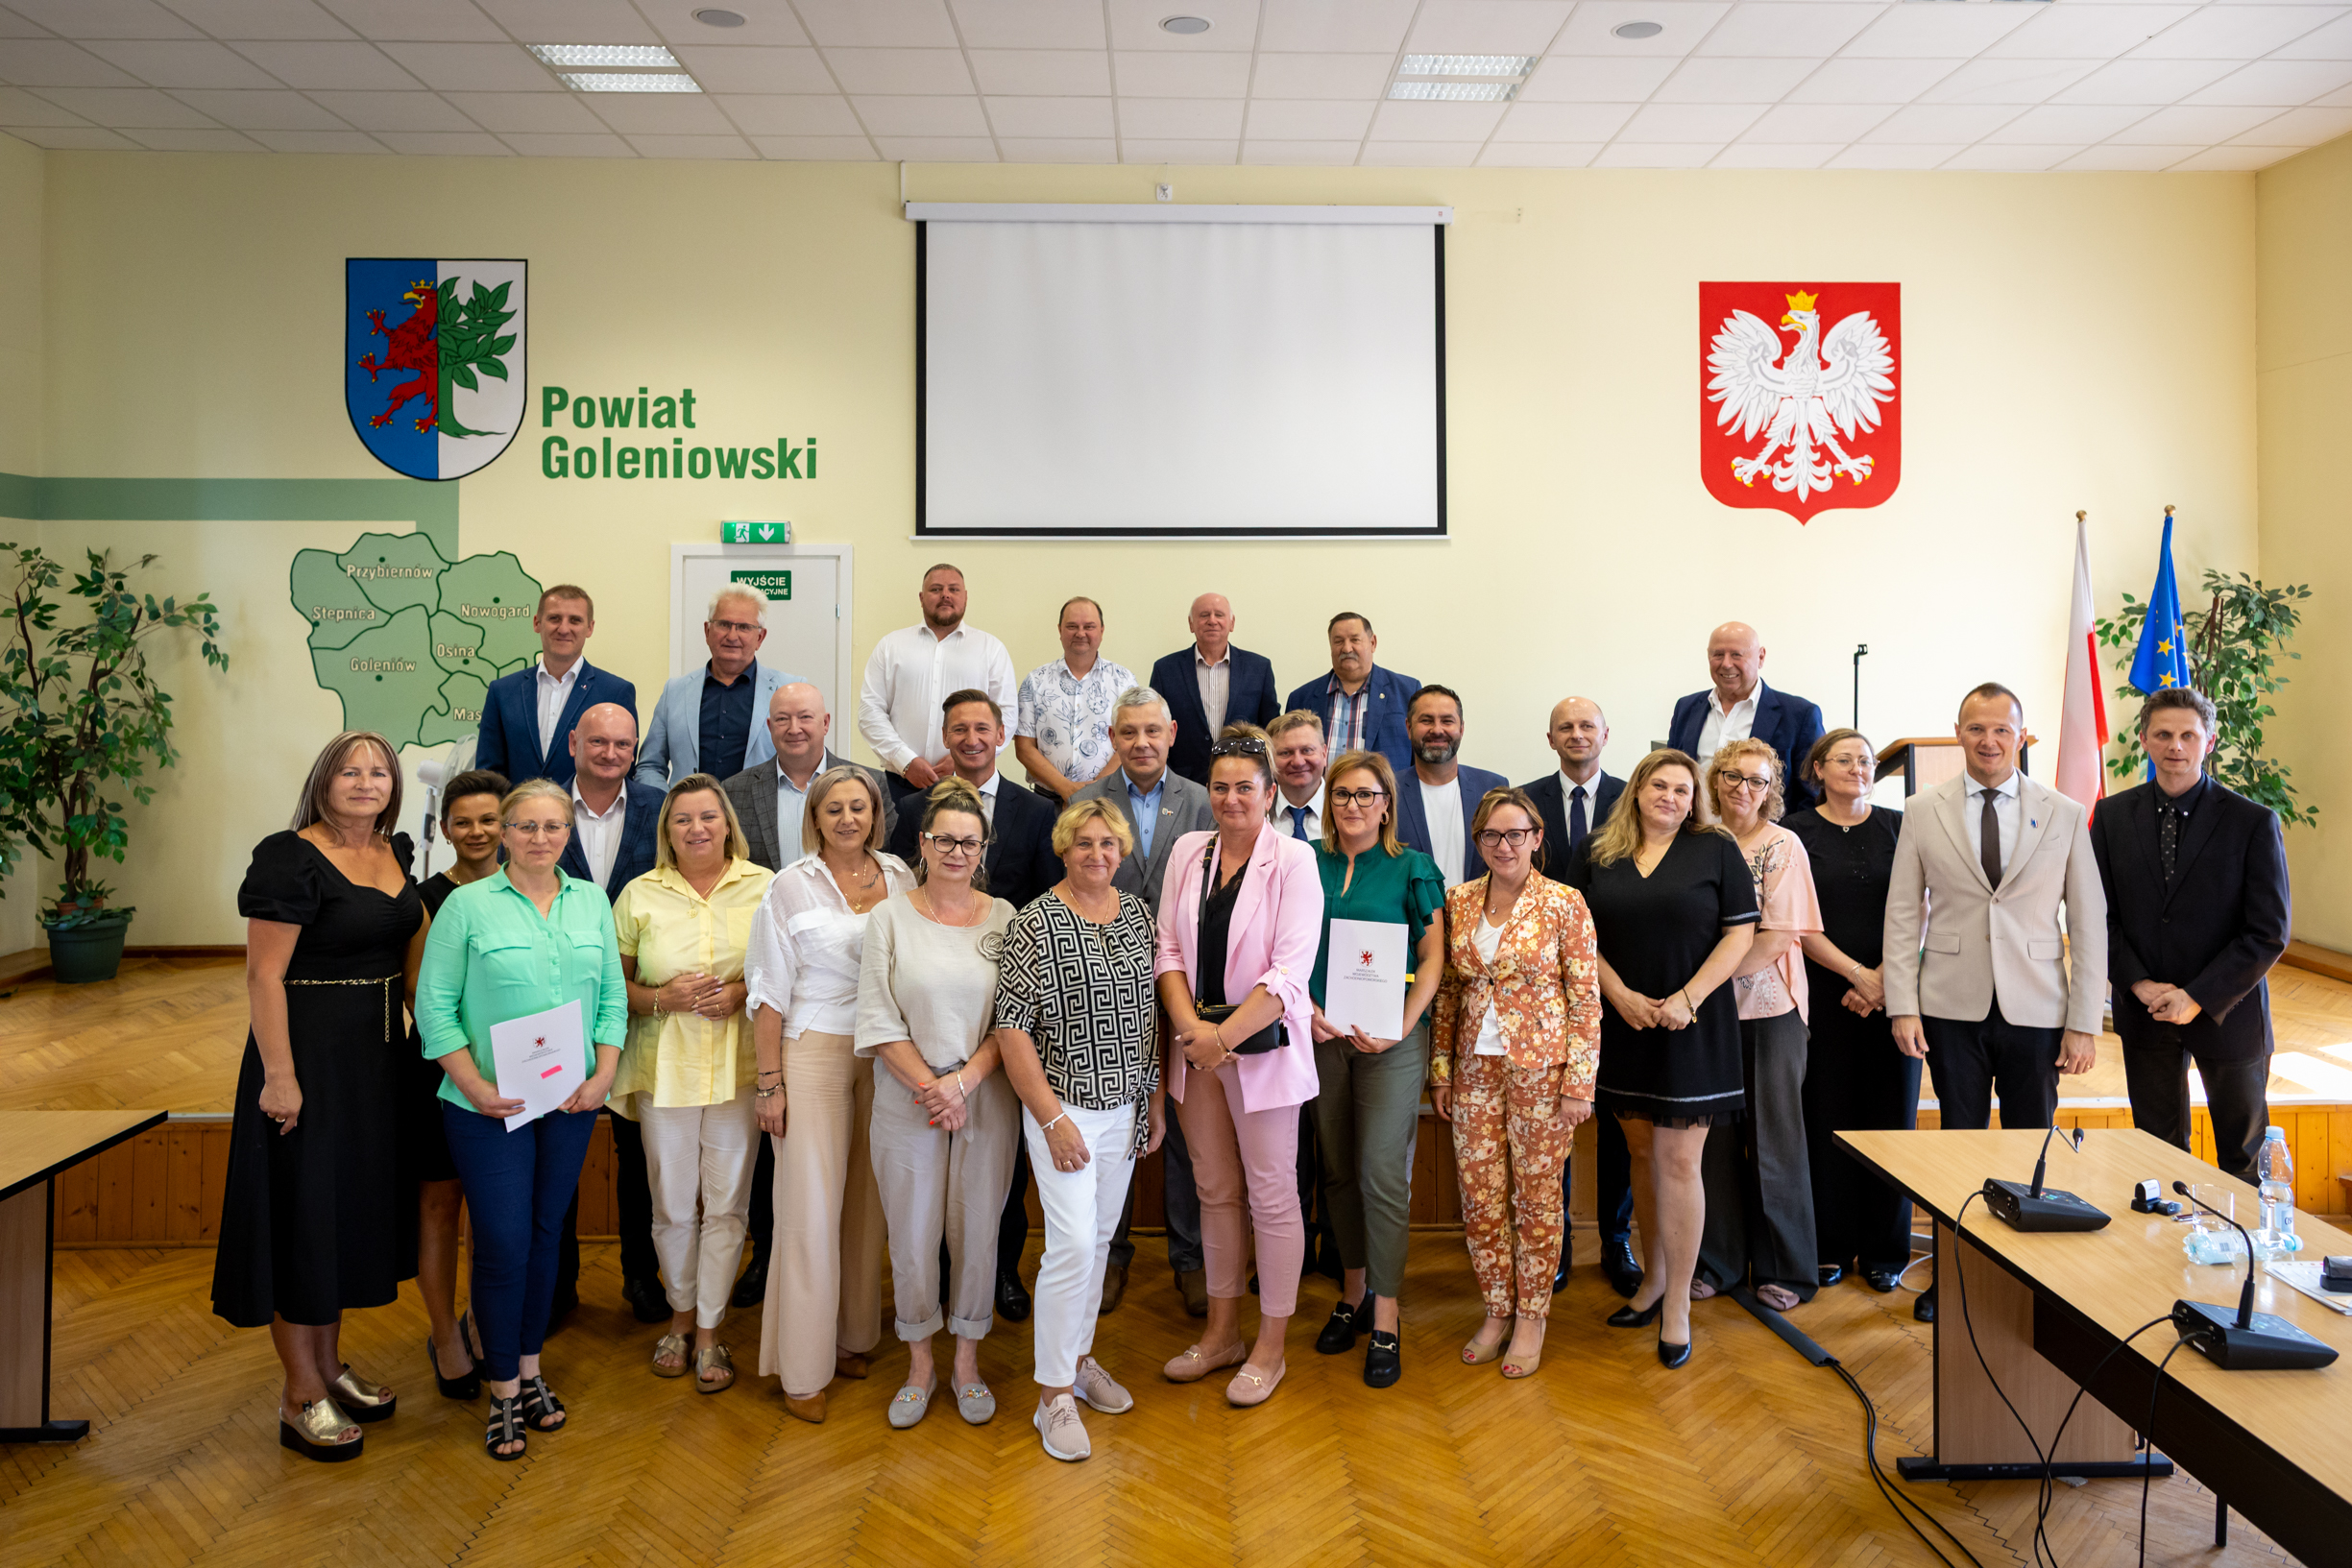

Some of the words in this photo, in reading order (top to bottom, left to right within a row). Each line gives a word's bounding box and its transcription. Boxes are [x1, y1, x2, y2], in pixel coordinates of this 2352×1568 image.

[542, 386, 696, 429] Powiat
[542, 435, 816, 480] Goleniowski
[346, 563, 433, 581] Przybiernów
[737, 575, 786, 586] WYJŚCIE
[312, 606, 376, 622] Stepnica
[461, 603, 531, 620] Nowogard
[436, 643, 475, 658] Osina
[350, 656, 417, 672] Goleniów
[453, 708, 482, 721] Mas
